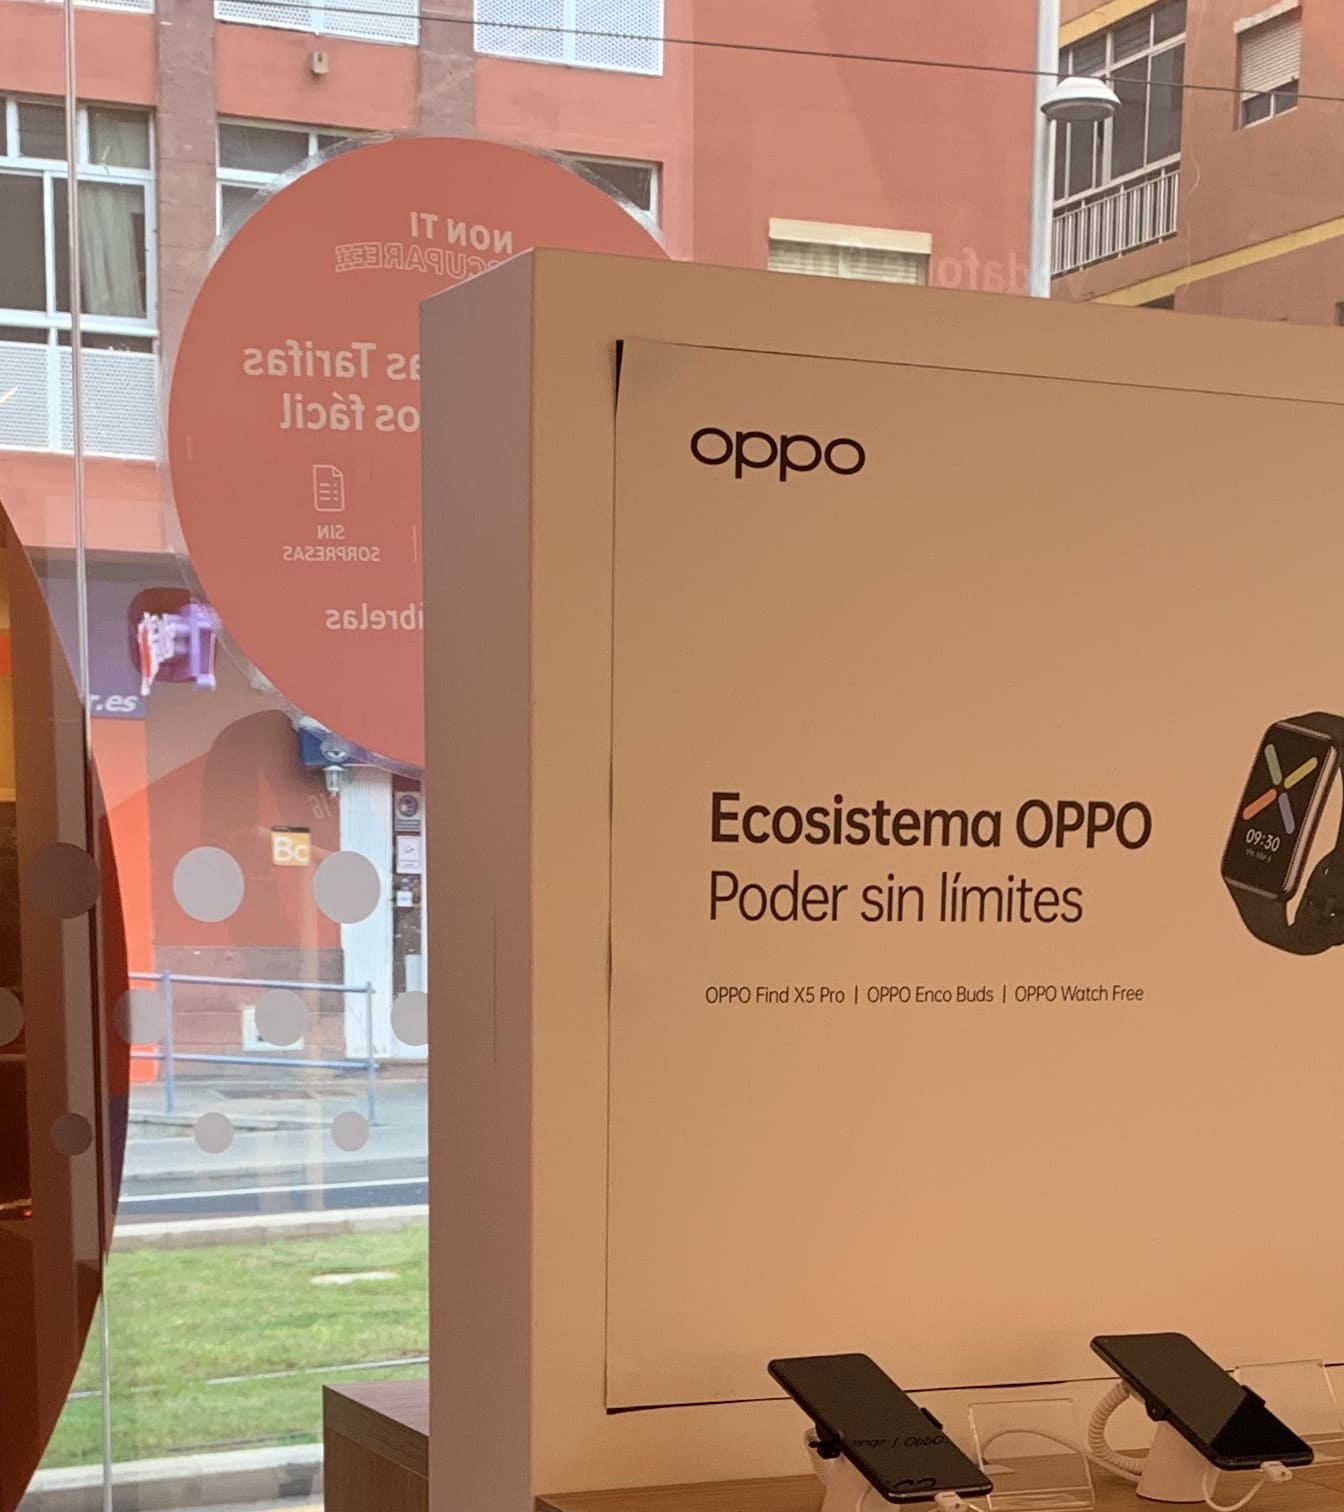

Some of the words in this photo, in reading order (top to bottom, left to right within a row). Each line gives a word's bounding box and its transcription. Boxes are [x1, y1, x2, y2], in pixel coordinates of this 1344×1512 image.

[711, 791, 1003, 848] Ecosistema
[1015, 798, 1153, 849] OPPO
[1245, 827, 1281, 854] 09:30
[709, 870, 848, 922] Poder
[860, 873, 925, 922] sin
[939, 871, 1084, 924] límites
[705, 986, 752, 1004] OPPO
[756, 985, 790, 1004] Find
[794, 986, 817, 1004] X5
[820, 986, 846, 1004] Pro
[866, 986, 912, 1004] OPPO
[915, 986, 953, 1004] Enco
[956, 985, 995, 1003] Buds
[1014, 985, 1057, 1003] OPPO
[1060, 985, 1109, 1003] Watch
[1112, 985, 1145, 1002] Free
